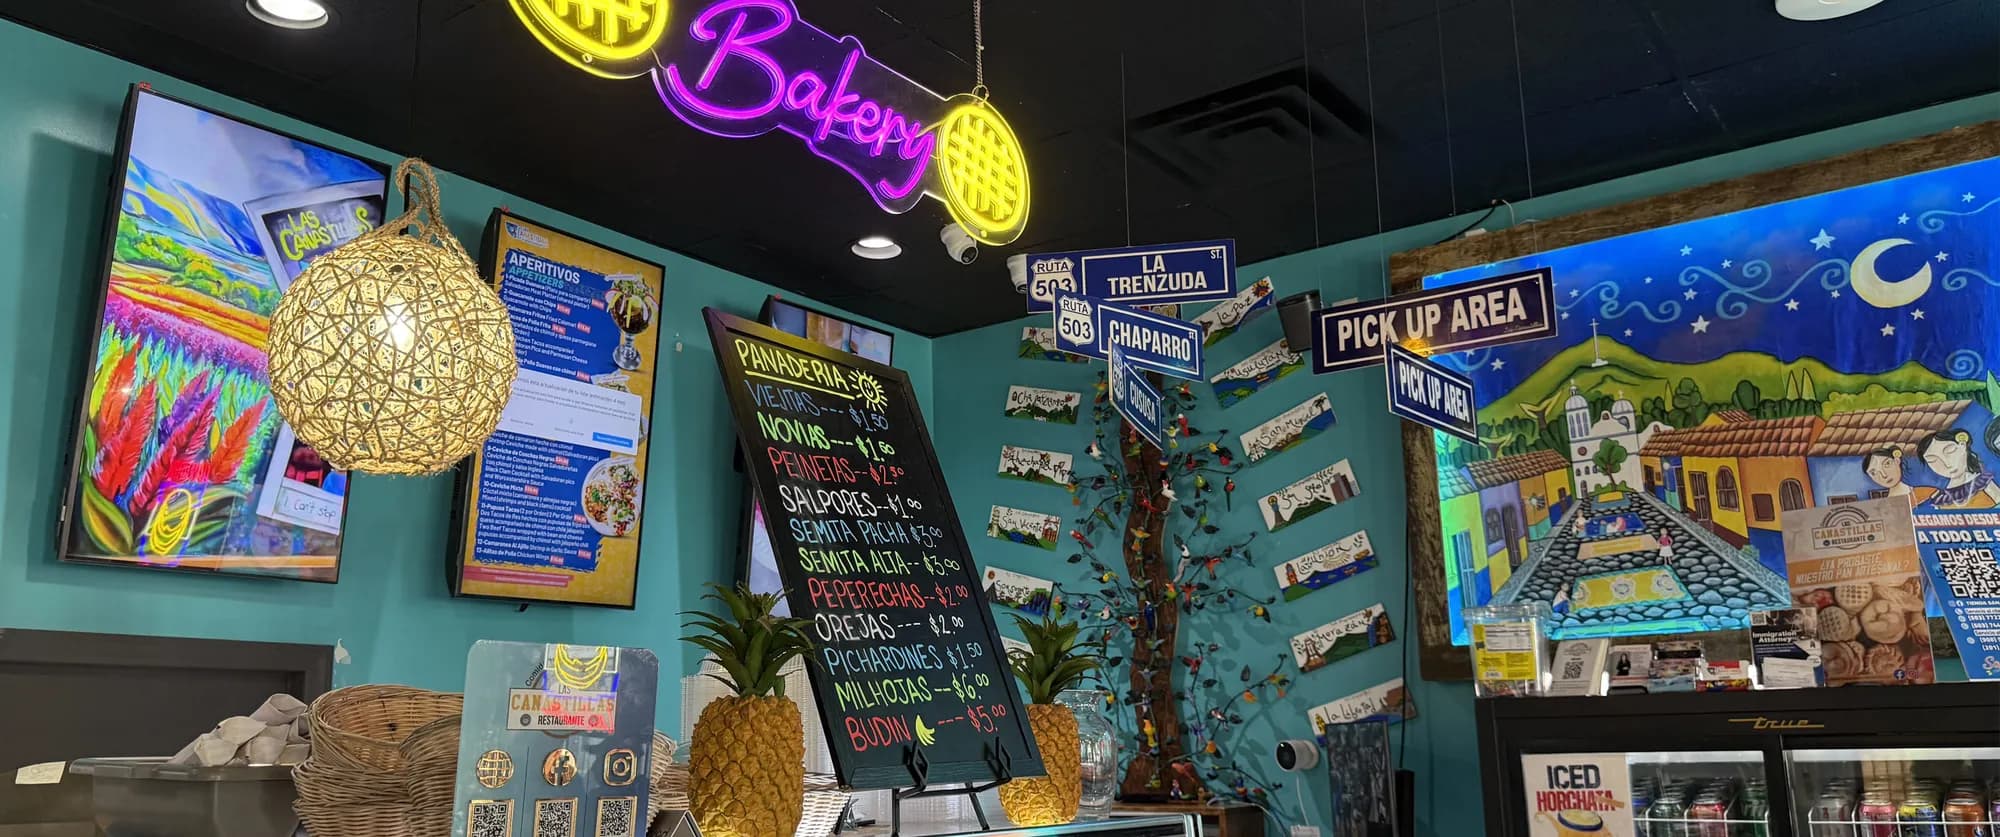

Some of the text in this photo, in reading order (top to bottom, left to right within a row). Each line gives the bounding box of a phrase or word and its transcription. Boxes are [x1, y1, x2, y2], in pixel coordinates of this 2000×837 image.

[665, 0, 935, 199] Bakery
[287, 211, 320, 232] LAS
[509, 251, 580, 284] APERITIVOS
[1036, 261, 1069, 273] RUTA
[1141, 254, 1166, 273] LA
[508, 264, 563, 288] APPETIZERS
[1036, 278, 1073, 296] 503
[1107, 271, 1208, 295] TRENZUDA
[1062, 299, 1089, 315] RUTA
[1061, 318, 1091, 340] 503
[1337, 287, 1527, 352] PICK UP AREA
[1109, 319, 1191, 362] CHAPARRO
[735, 339, 850, 391] PANADERIA
[1129, 380, 1156, 426] CUSUSA
[1399, 360, 1470, 423] PICK UP AREA
[744, 379, 889, 432] VIEJITAS $1.50
[757, 411, 831, 450] NOVIAS
[1260, 426, 1282, 446] San
[767, 446, 905, 487] PEINETAS $2.50
[779, 484, 922, 518] SALPORES $1.00
[1000, 515, 1018, 529] San
[1815, 523, 1882, 540] CANASTILLAS
[1913, 513, 1998, 527] LEGAMOS DESDE
[789, 518, 943, 548] SEMITA PACHA $3.00
[1832, 535, 1866, 545] RESTAURANTE
[1918, 530, 1930, 544] A
[1929, 530, 1972, 543] TODO
[1972, 530, 1994, 543] EL
[798, 546, 960, 577] SEMITA ALTA $3.00
[1837, 552, 1881, 569] PROBASTE
[1796, 567, 1834, 585] NUESTRO
[1836, 565, 1853, 580] PAN
[807, 577, 969, 609] PEPERECHAS $2.00
[814, 613, 964, 642] OREJAS $2.00
[1752, 631, 1797, 639] Immigration
[823, 641, 983, 676] PICHARDINES $1.50
[525, 663, 545, 687] Comid
[559, 685, 571, 694] LAS
[834, 671, 990, 712] MILHOJAS $6.00
[511, 694, 614, 711] CANASTILLAS
[538, 715, 584, 726] RESTAURANTE
[845, 703, 1007, 752] BUDIN $5.00
[1740, 716, 1817, 729] true
[1546, 764, 1600, 789] ICED
[1536, 790, 1616, 811] HORCHATA
